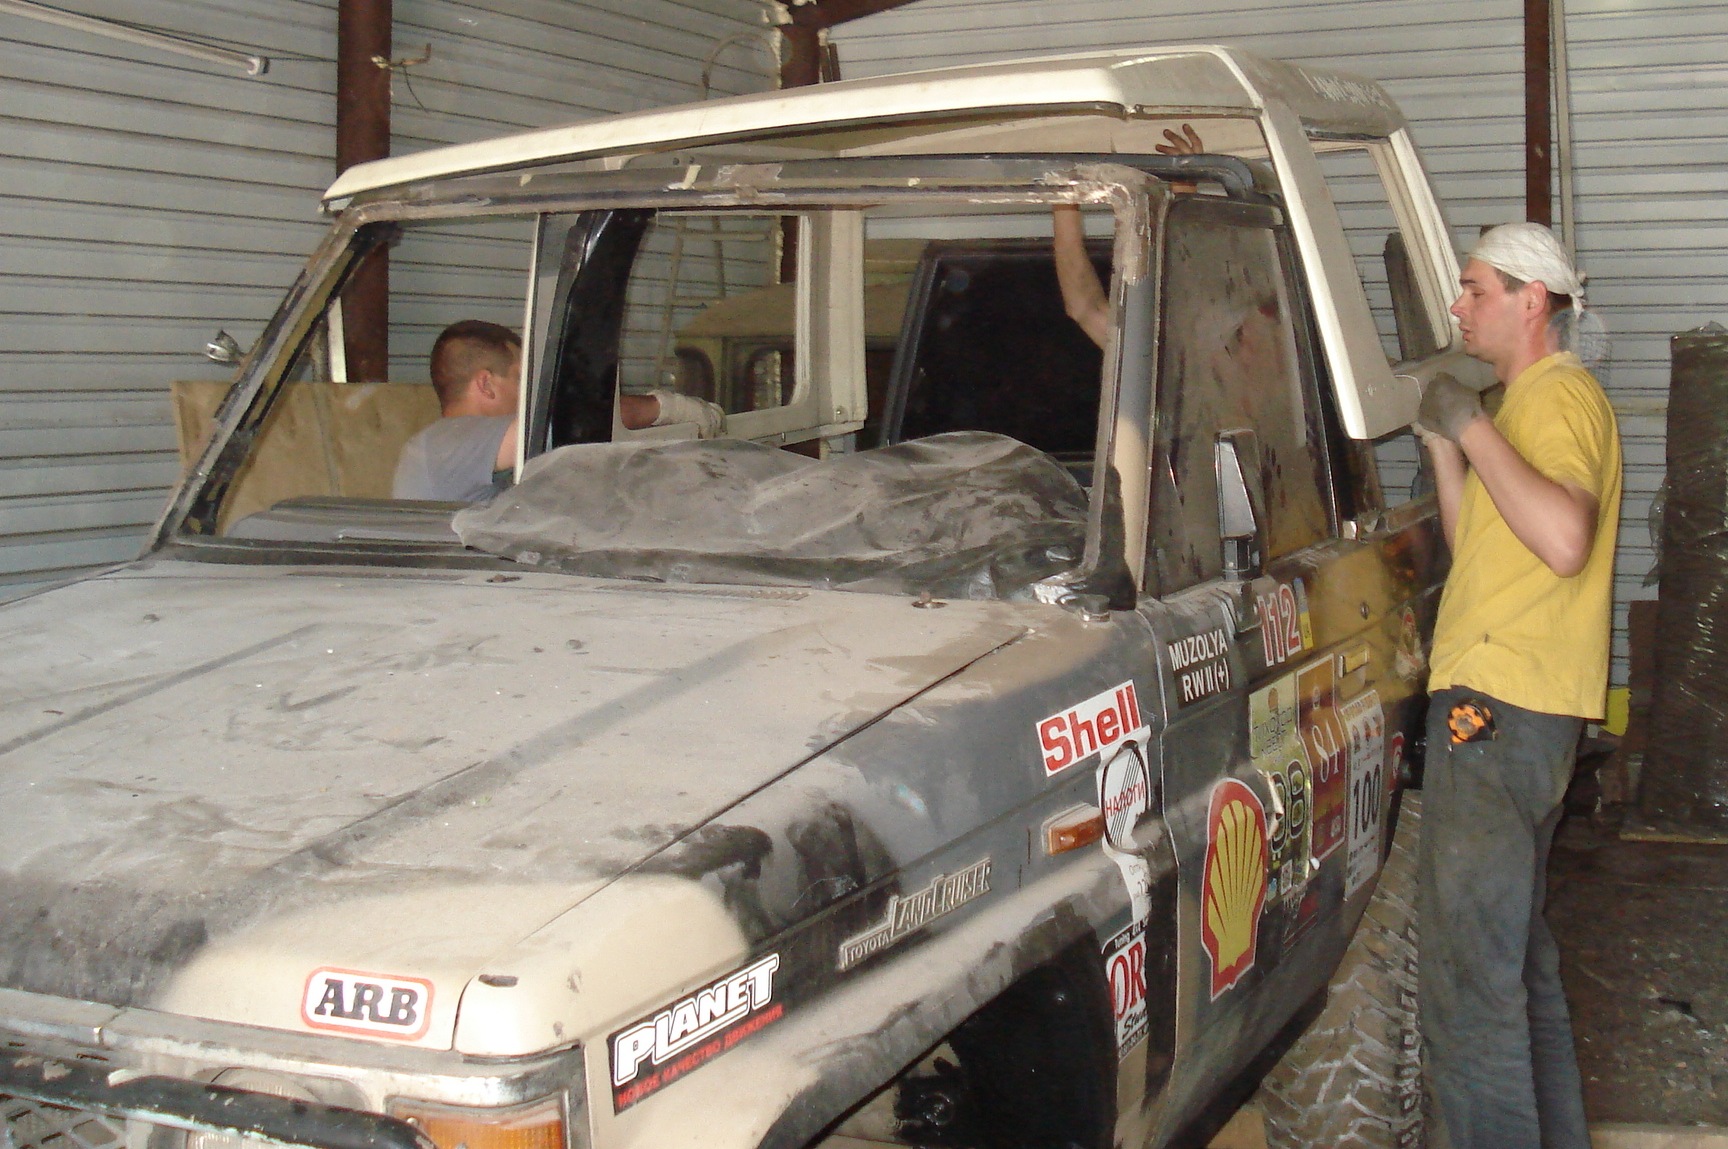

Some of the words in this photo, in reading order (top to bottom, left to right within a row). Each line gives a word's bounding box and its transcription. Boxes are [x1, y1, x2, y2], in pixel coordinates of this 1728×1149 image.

[1169, 629, 1228, 671] MUZOLYA
[1257, 584, 1301, 667] 112
[1040, 685, 1141, 771] Shell
[1353, 763, 1381, 840] 100
[850, 932, 889, 962] TOYOTA
[314, 978, 419, 1026] ARB
[614, 953, 780, 1086] PLANET
